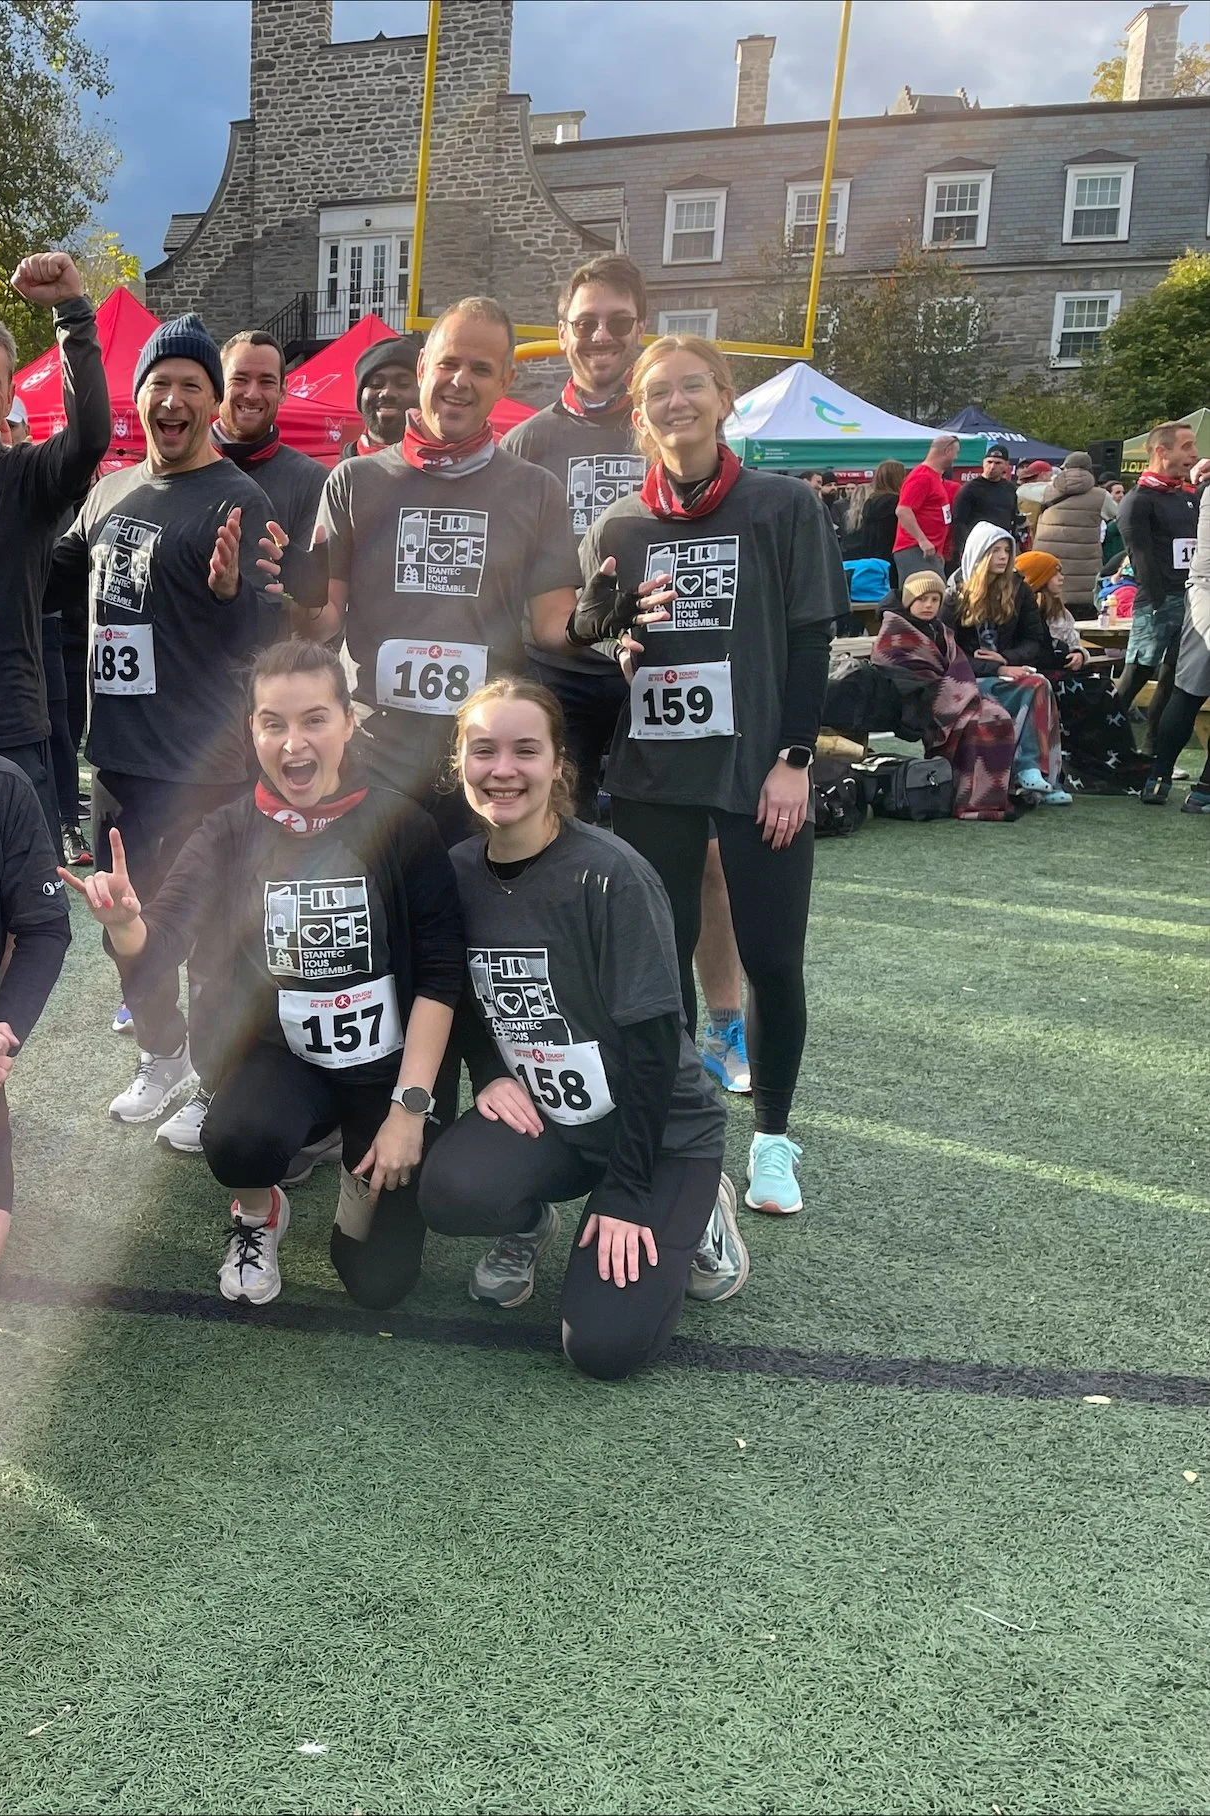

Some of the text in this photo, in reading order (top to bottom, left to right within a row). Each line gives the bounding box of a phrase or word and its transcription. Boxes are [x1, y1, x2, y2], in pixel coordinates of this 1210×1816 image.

[427, 566, 461, 576] STANTEC
[427, 575, 448, 584] TOUS
[427, 583, 466, 593] ENSEMBLE
[676, 600, 713, 610] STANTEC
[676, 610, 699, 619] TOUS
[676, 618, 720, 628] ENSEMBLE
[94, 644, 140, 682] 183
[393, 661, 470, 702] 168
[642, 685, 713, 725] 159
[303, 950, 345, 960] STANTEC
[303, 960, 329, 969] TOUS
[304, 964, 353, 977] ENSEMBLE
[352, 990, 372, 1000] TOUGH
[302, 1003, 384, 1054] 157
[515, 1063, 592, 1111] 158
